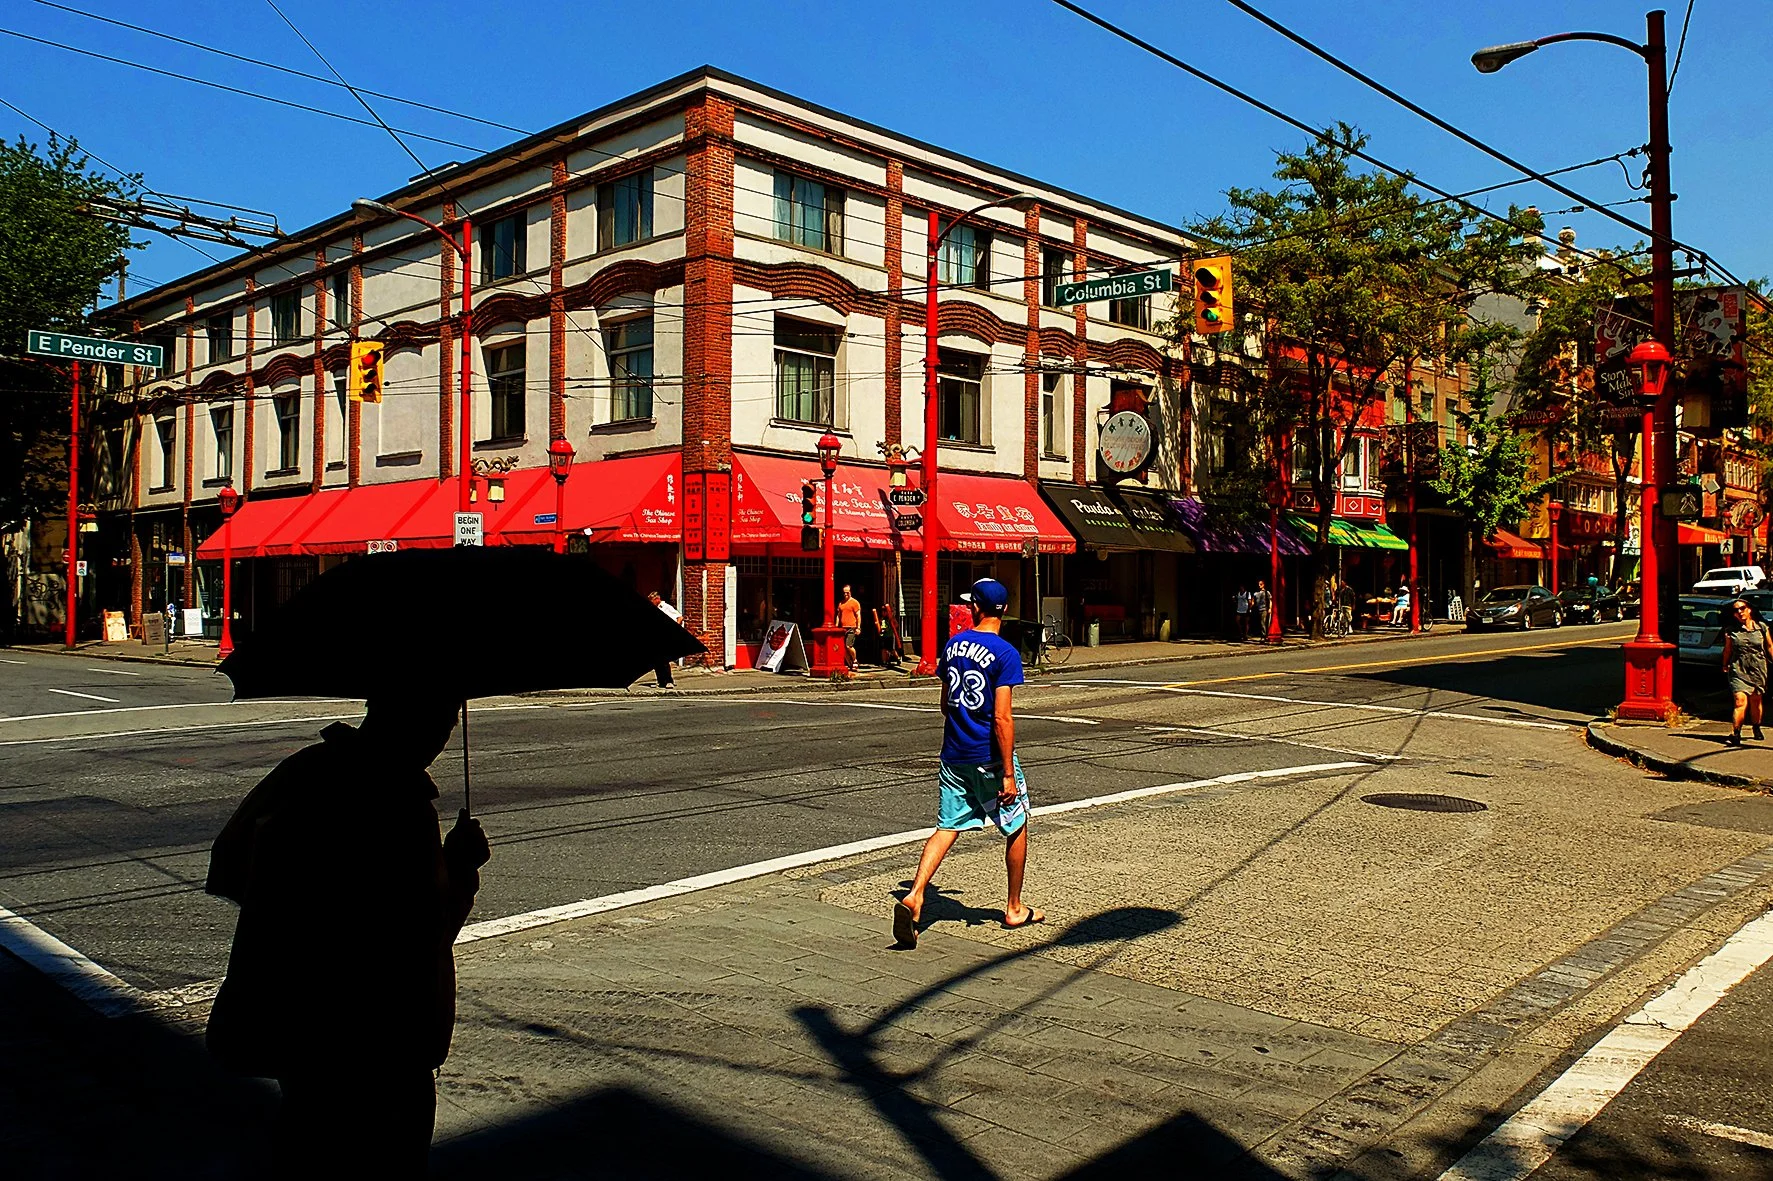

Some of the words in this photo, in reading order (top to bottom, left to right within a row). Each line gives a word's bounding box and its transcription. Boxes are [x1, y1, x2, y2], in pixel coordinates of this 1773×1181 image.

[1064, 280, 1136, 302] Columbia
[1143, 274, 1162, 291] St
[38, 335, 52, 351] E
[60, 338, 125, 360] Pender
[133, 347, 153, 363] St
[1601, 369, 1626, 384] Story
[785, 493, 802, 504] Th
[898, 495, 916, 503] PENDER
[642, 508, 654, 517] The
[654, 509, 676, 517] Chinese
[747, 508, 764, 516] Chinese
[1070, 499, 1115, 516] Panda
[458, 516, 479, 524] BEGIN
[645, 516, 657, 524] Tea
[657, 517, 673, 526] Shop
[1084, 519, 1132, 529] BEVERAGES
[946, 640, 996, 669] RASMUS
